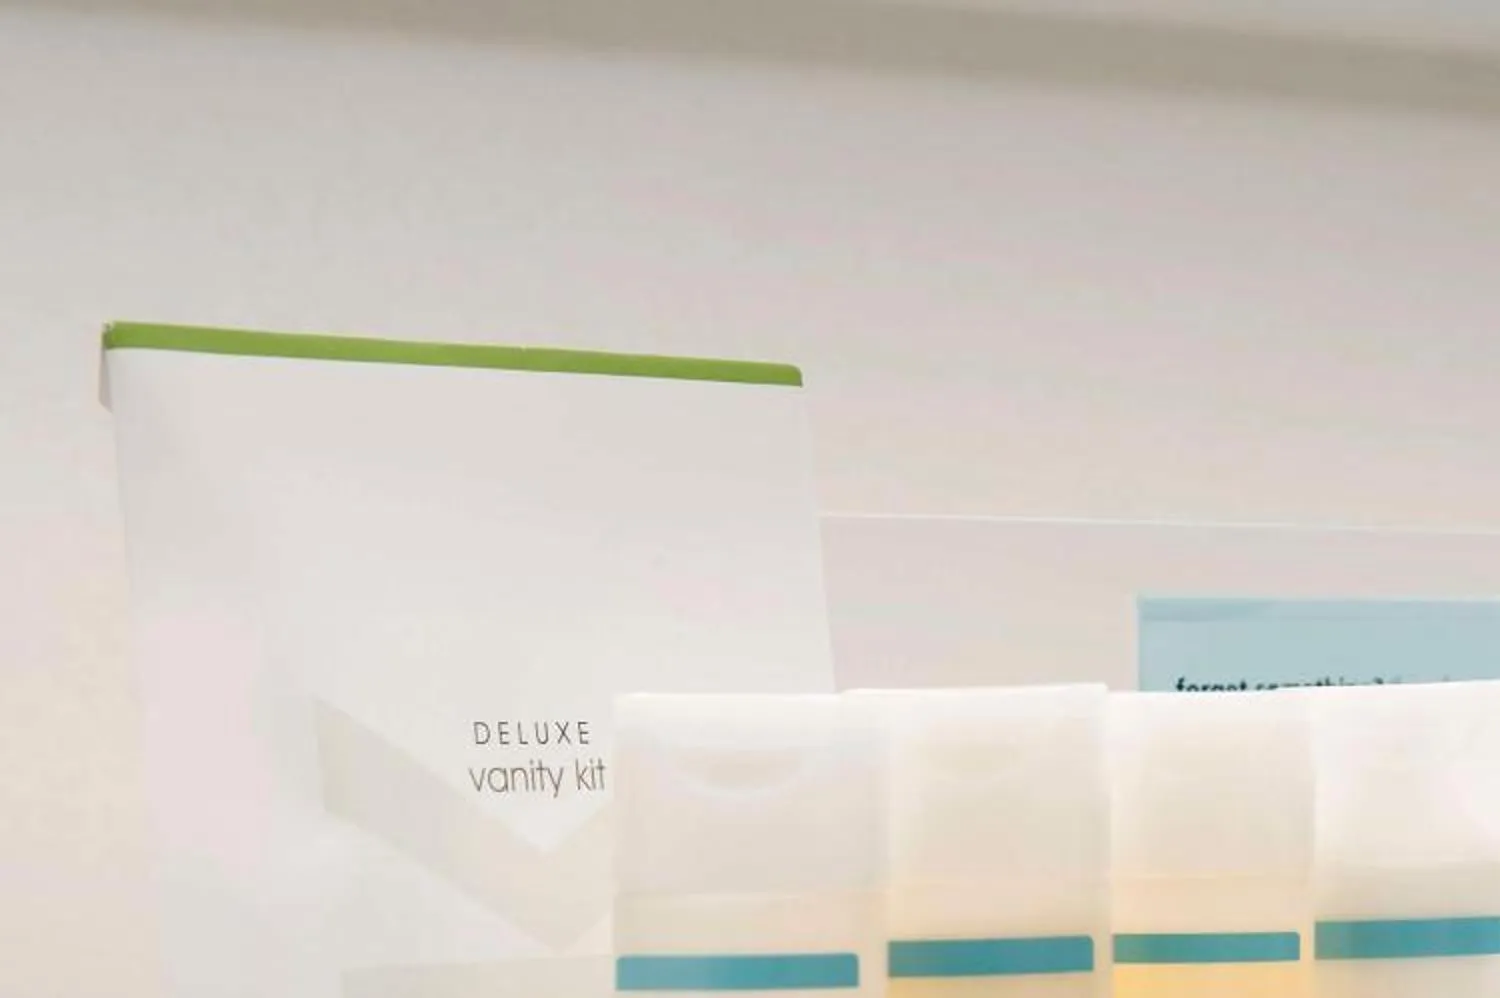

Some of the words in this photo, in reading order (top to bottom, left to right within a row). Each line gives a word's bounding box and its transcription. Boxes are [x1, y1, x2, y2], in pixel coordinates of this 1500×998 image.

[473, 721, 590, 745] DELUXE
[468, 759, 564, 798] vanity
[574, 757, 606, 791] kit
